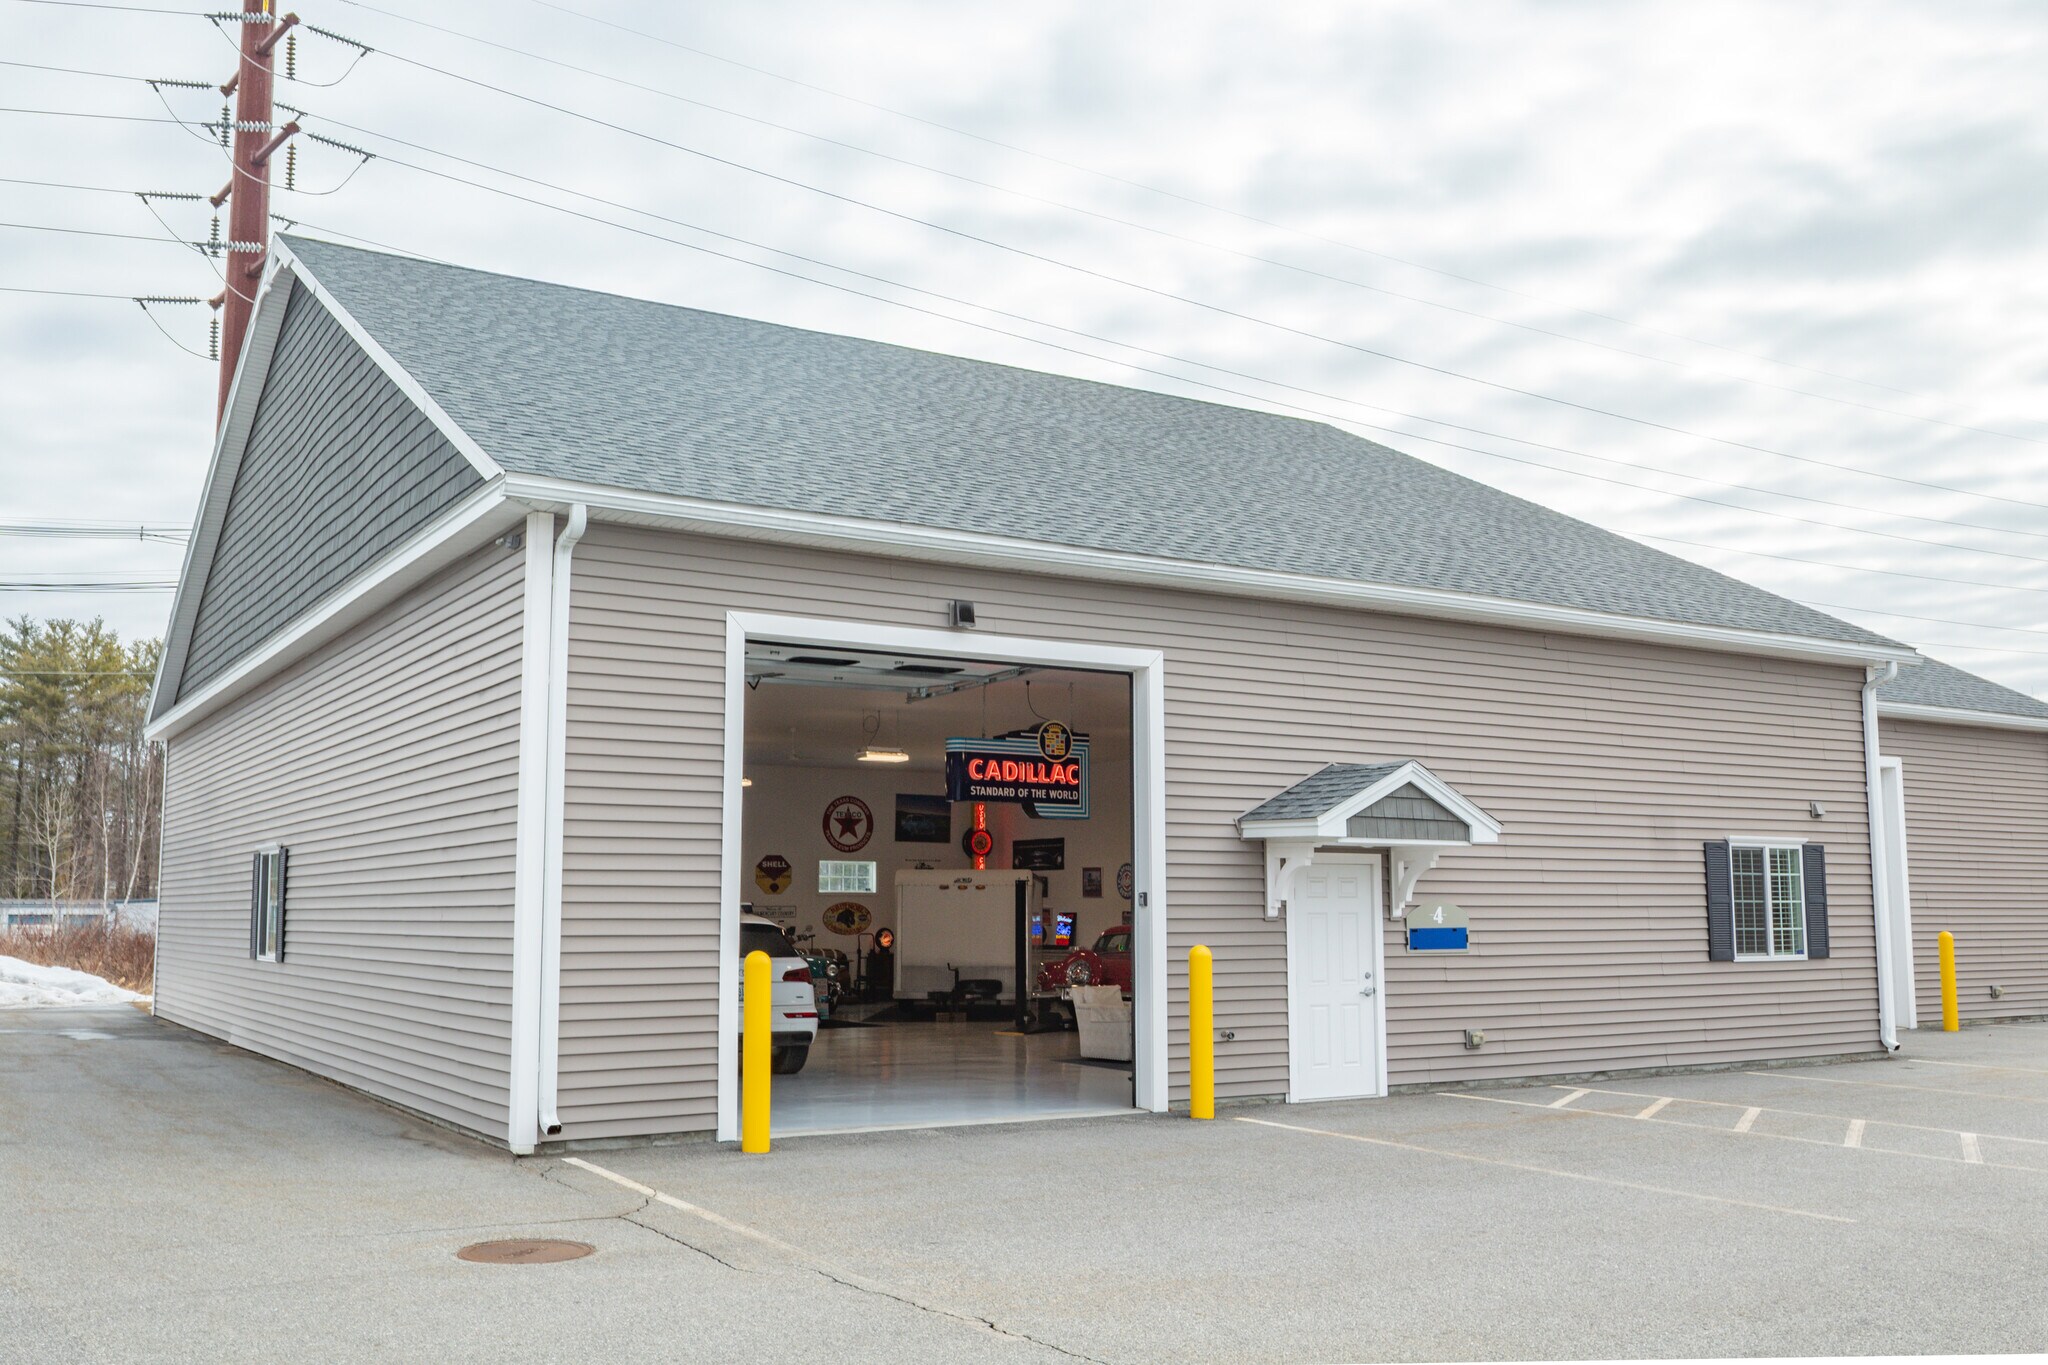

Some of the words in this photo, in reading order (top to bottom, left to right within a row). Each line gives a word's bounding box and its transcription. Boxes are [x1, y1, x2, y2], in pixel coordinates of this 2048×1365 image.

[968, 758, 1079, 786] CADILLAC
[970, 785, 1015, 797] STANDARD
[1017, 788, 1029, 798] OF
[1031, 789, 1047, 799] THE
[1049, 790, 1079, 800] WORLD
[761, 860, 787, 868] SHELL
[1433, 906, 1443, 924] 4
